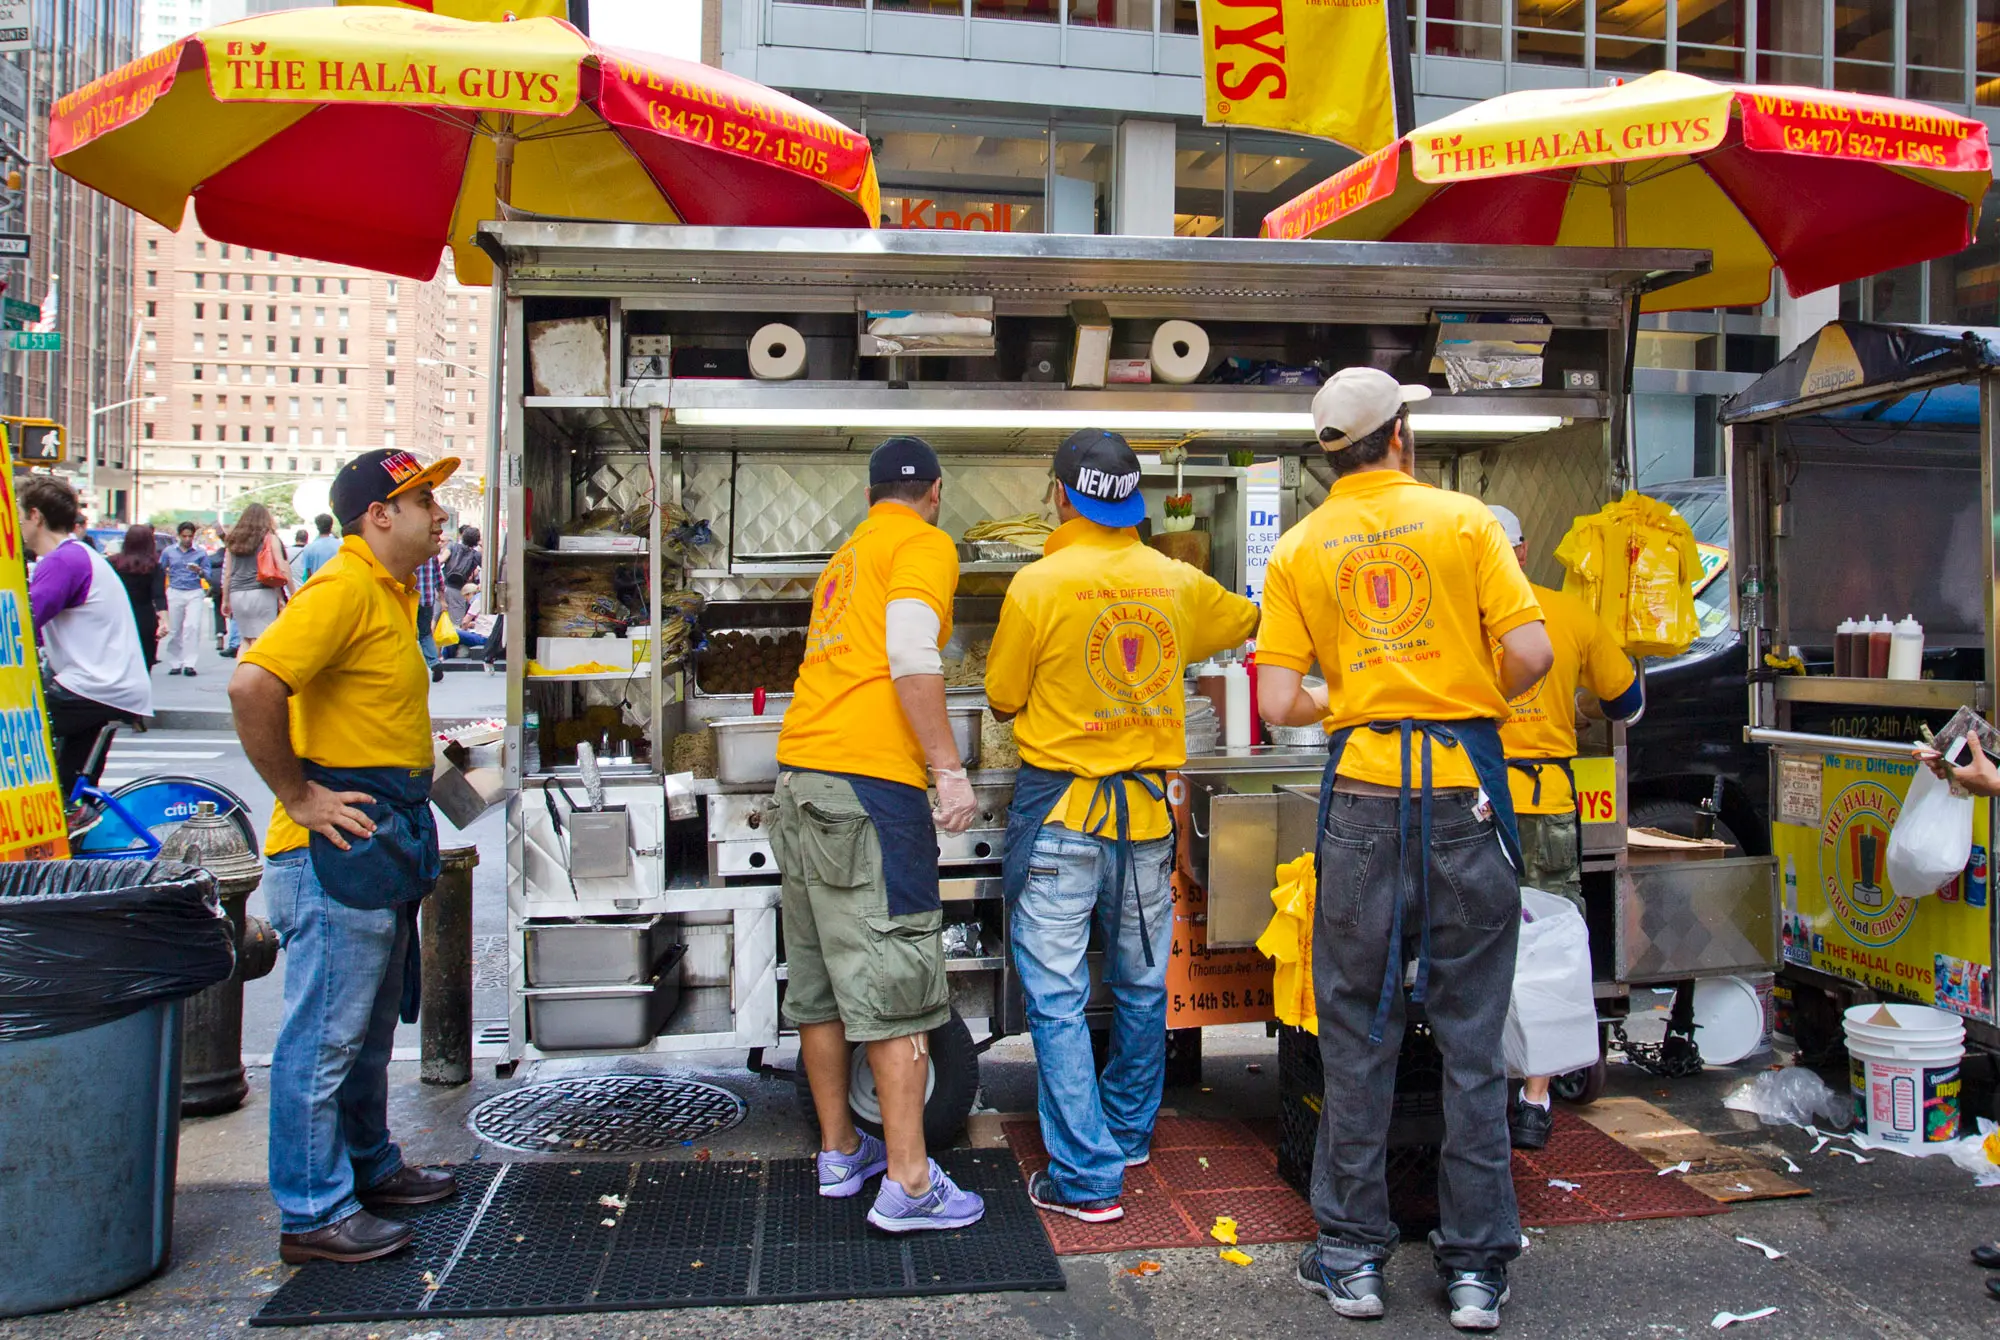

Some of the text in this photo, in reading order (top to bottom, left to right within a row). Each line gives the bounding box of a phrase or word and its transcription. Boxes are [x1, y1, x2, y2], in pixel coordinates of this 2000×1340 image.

[1214, 0, 1287, 100] YS
[227, 60, 560, 104] THE HALAL GUYS
[616, 58, 853, 150] WE ARE CATERING
[1753, 92, 1968, 140] WE ARE CATERING
[648, 101, 828, 175] (347) 527-1505
[1431, 117, 1710, 174] THE HALAL GUYS
[1783, 125, 1946, 165] (347) 527-1505
[902, 199, 1011, 232] Knoll
[31, 335, 45, 348] 53
[1808, 369, 1856, 393] Snapple
[1076, 466, 1115, 498] NEW
[1323, 522, 1425, 549] WE ARE DIFFERENT
[1340, 548, 1425, 592] THE HALAL GUYS
[1076, 588, 1176, 600] WE ARE DIFFERENT
[1348, 597, 1427, 636] GYRO and CHICKEN
[1090, 607, 1176, 665] THE HALAL GUYS
[1364, 646, 1380, 656] Ave.
[1392, 640, 1414, 651] 53rd
[1416, 638, 1429, 647] St.
[1368, 650, 1440, 668] THE HALAL GUYS
[1096, 667, 1172, 701] GYRO and CHICKEN
[1094, 708, 1112, 719] 6th
[1131, 706, 1138, 714] &
[1141, 705, 1160, 717] 53rd
[1105, 718, 1182, 732] THE HALAL GUYS
[1830, 718, 1868, 738] 10-02
[1871, 718, 1900, 738] 34th
[1824, 754, 1919, 776] We are Different
[20, 790, 62, 839] GUYS
[1824, 807, 1844, 848] THE
[1843, 788, 1884, 814] HALAL
[24, 842, 54, 860] MENU
[1171, 886, 1182, 904] 3-
[1828, 875, 1849, 918] GYRO
[1850, 916, 1868, 936] and
[1172, 940, 1182, 958] 4-
[1825, 942, 1932, 984] THE HALAL GUYS
[1188, 961, 1234, 982] (Thomson
[1820, 960, 1842, 974] 53rd
[1864, 973, 1872, 986] &
[1875, 976, 1894, 992] 6th
[1898, 982, 1923, 1000] Ave.
[1174, 995, 1186, 1012] 5-
[1190, 992, 1218, 1011] 14th
[1222, 990, 1239, 1008] St.
[1244, 989, 1254, 1007] &
